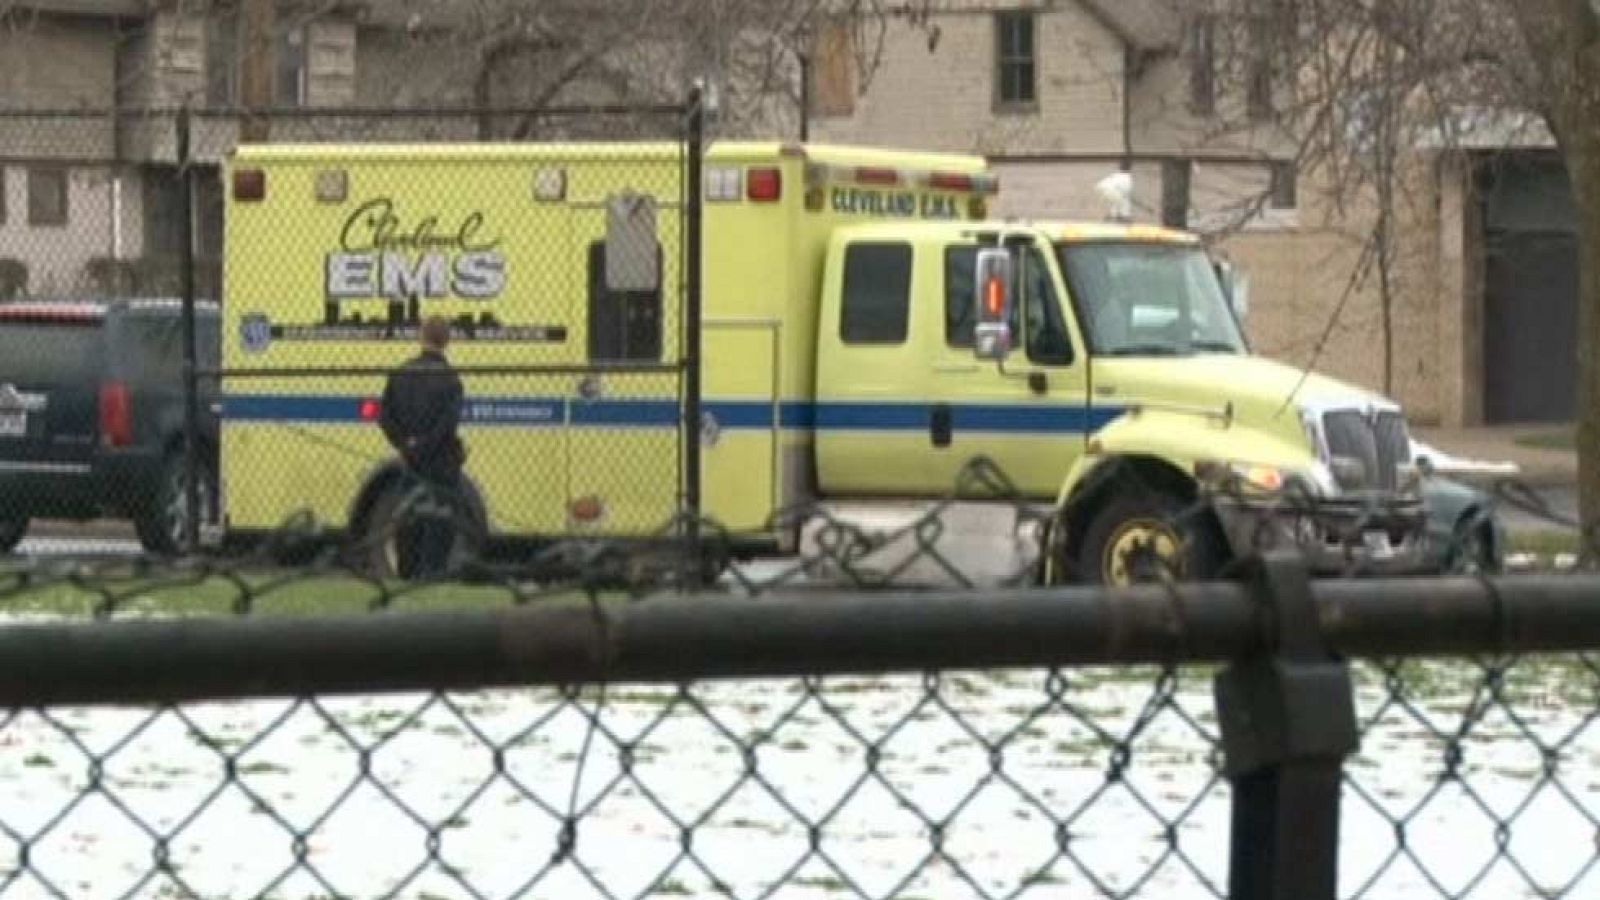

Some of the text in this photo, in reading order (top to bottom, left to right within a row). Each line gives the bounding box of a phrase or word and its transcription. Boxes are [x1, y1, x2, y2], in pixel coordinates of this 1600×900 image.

[339, 198, 503, 252] Cleveland
[832, 187, 914, 217] CLEVELAND
[324, 251, 506, 299] EMS
